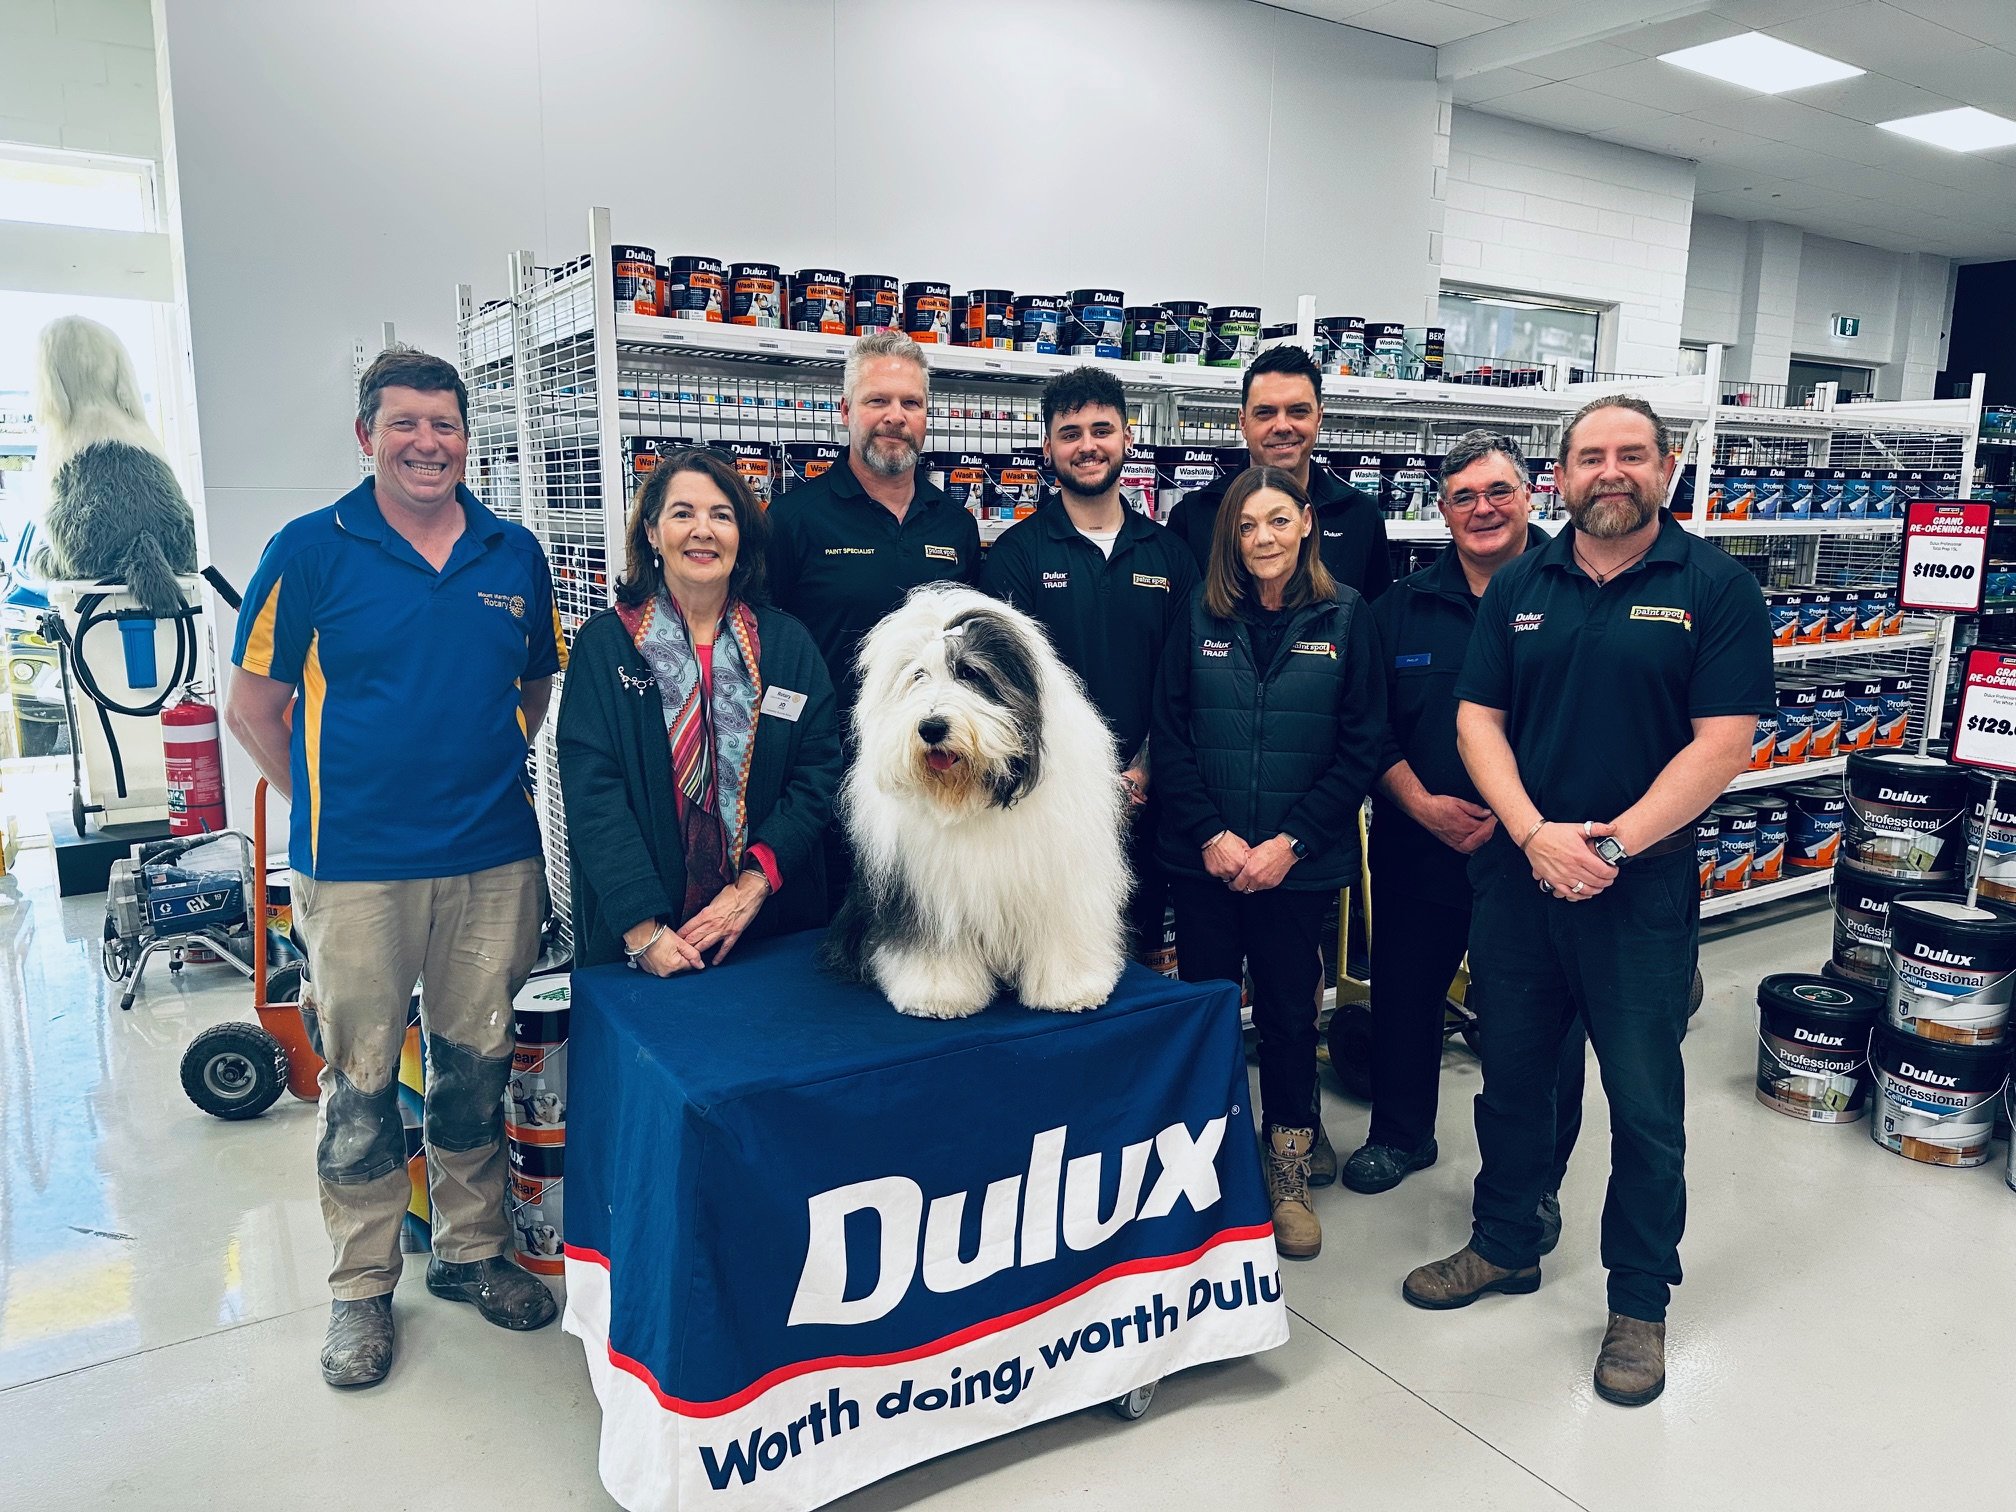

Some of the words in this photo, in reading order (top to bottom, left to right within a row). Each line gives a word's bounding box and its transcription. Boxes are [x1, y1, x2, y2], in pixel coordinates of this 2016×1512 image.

[625, 249, 653, 262] Dulux
[698, 261, 721, 272] Dulu
[742, 267, 768, 276] Dulux
[814, 273, 841, 284] Dulux
[884, 280, 898, 289] Dul
[925, 285, 948, 295] Dulux
[1032, 298, 1055, 309] Dulux
[1094, 293, 1120, 304] Dulux
[1229, 309, 1256, 319] Dulux
[1350, 320, 1365, 329] Dulu
[1383, 326, 1403, 335] Dulu
[817, 447, 840, 459] Dulu
[1184, 450, 1213, 462] Dulux
[960, 455, 983, 465] Dulux
[1012, 456, 1036, 466] Dulux
[1360, 456, 1381, 466] Dulu
[1406, 457, 1426, 467] Dulu
[1932, 517, 1964, 525] GRAND
[1909, 524, 1963, 533] RE-OPENING
[1963, 525, 1987, 535] SALE
[1042, 572, 1067, 580] Dulux
[1912, 562, 1975, 580] $119.00
[1042, 581, 1068, 589] TRADE
[483, 597, 508, 610] Rotary
[1515, 612, 1544, 622] Dulux
[1635, 608, 1660, 617] paint
[1660, 611, 1681, 619] spot
[1513, 623, 1541, 633] TRADE
[1203, 639, 1231, 649] Dulux
[1293, 643, 1309, 651] aint
[1309, 644, 1327, 653] spot
[1202, 649, 1229, 658] TRADE
[1995, 667, 2016, 677] GRA
[1864, 684, 1882, 694] Dulu
[1897, 680, 1912, 690] Dul
[777, 691, 792, 700] Rotary
[1797, 694, 1817, 704] Dulu
[1966, 714, 2016, 736] $129.
[1878, 788, 1929, 804] Dulux
[1824, 802, 1845, 811] Dulu
[1974, 802, 2016, 824] Dlux
[1864, 810, 1940, 830] Professional
[186, 895, 210, 913] GX
[1859, 897, 1889, 913] Dul
[1847, 918, 1892, 938] Professi
[1914, 943, 1974, 967] Dulux
[1902, 959, 1984, 987] Professional
[1901, 972, 1927, 989] Ceiling
[1793, 1027, 1845, 1046] Dulux
[1780, 1048, 1854, 1071] Professional
[1899, 1062, 1958, 1087] Dulux
[1887, 1076, 1968, 1107] Professional
[1886, 1089, 1913, 1107] Ceiling
[787, 1111, 1227, 1328] Dulux
[699, 1387, 860, 1491] Worth
[876, 1357, 1034, 1420] doing,
[1039, 1293, 1179, 1372] worth
[1187, 1262, 1285, 1322] Dulu
